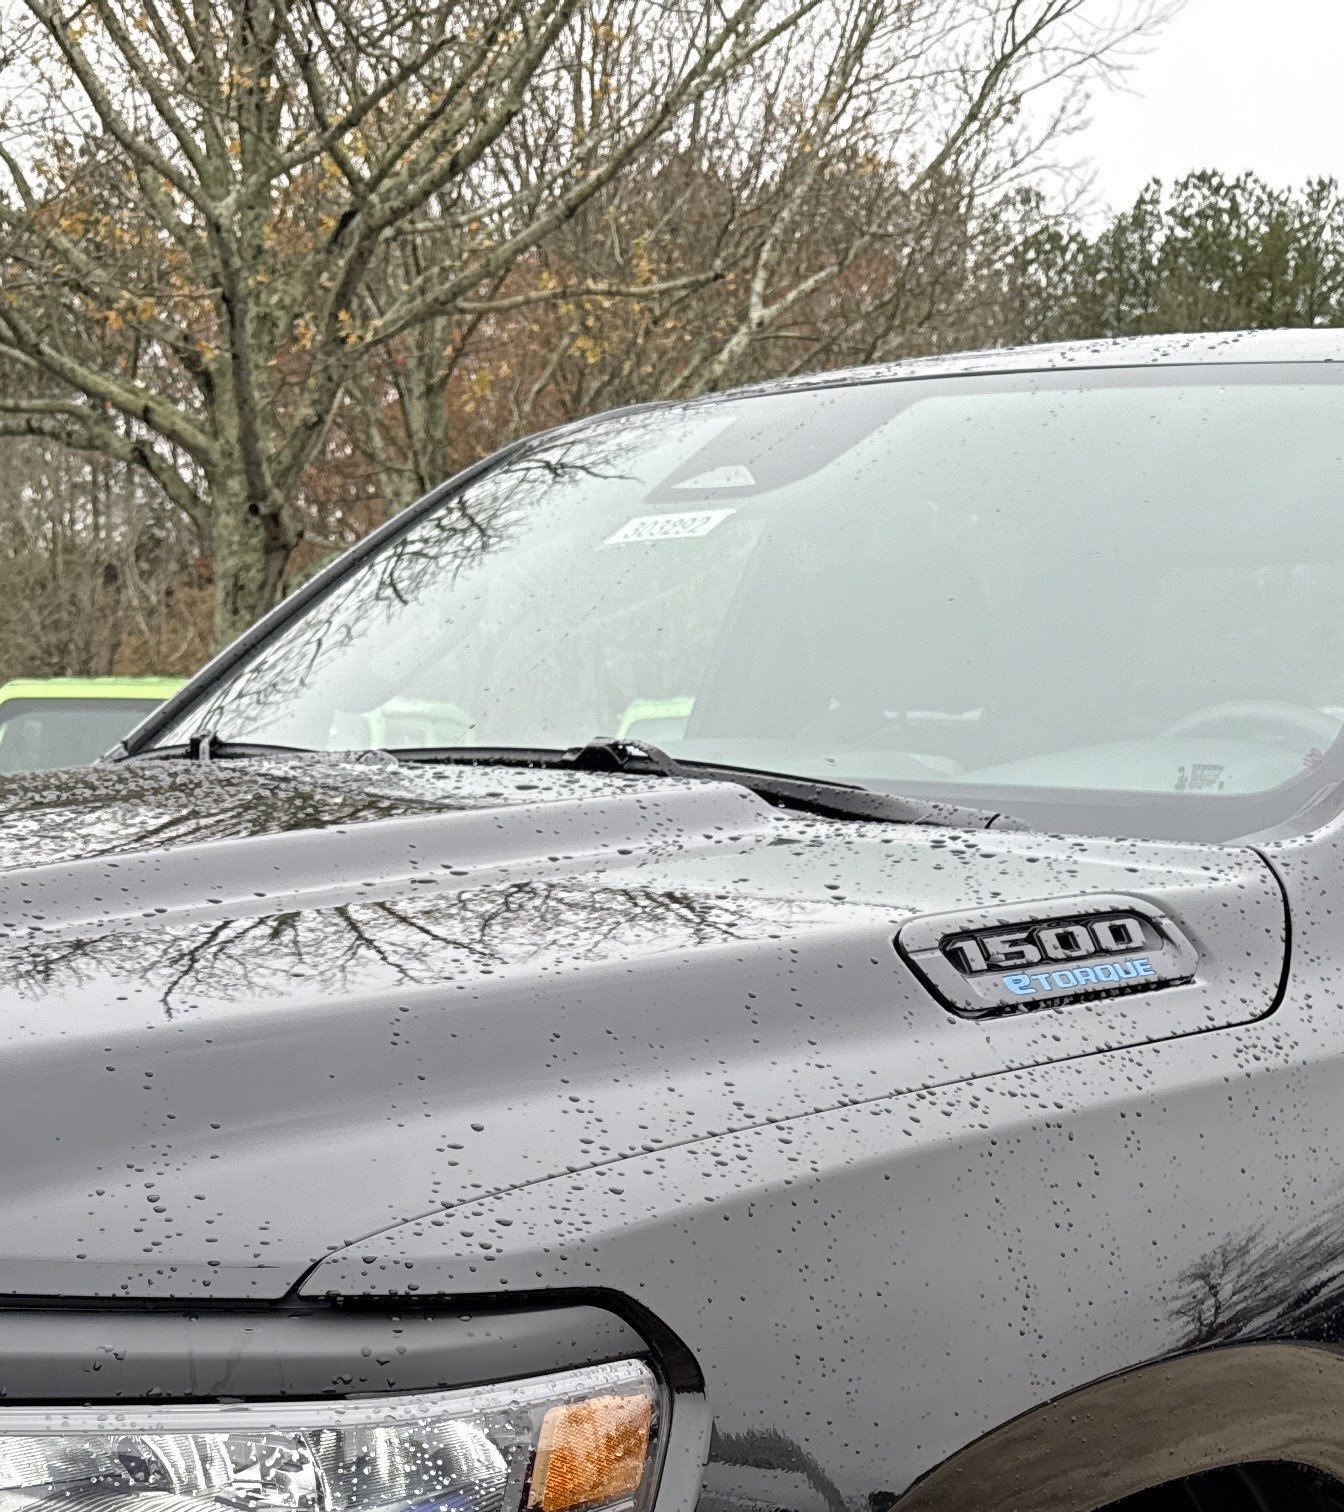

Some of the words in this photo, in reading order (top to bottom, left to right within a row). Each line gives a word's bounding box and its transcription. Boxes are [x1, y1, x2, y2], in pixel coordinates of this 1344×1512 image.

[623, 516, 712, 539] 303292
[945, 917, 1148, 973] 1500
[1002, 957, 1157, 996] eTORQUE
